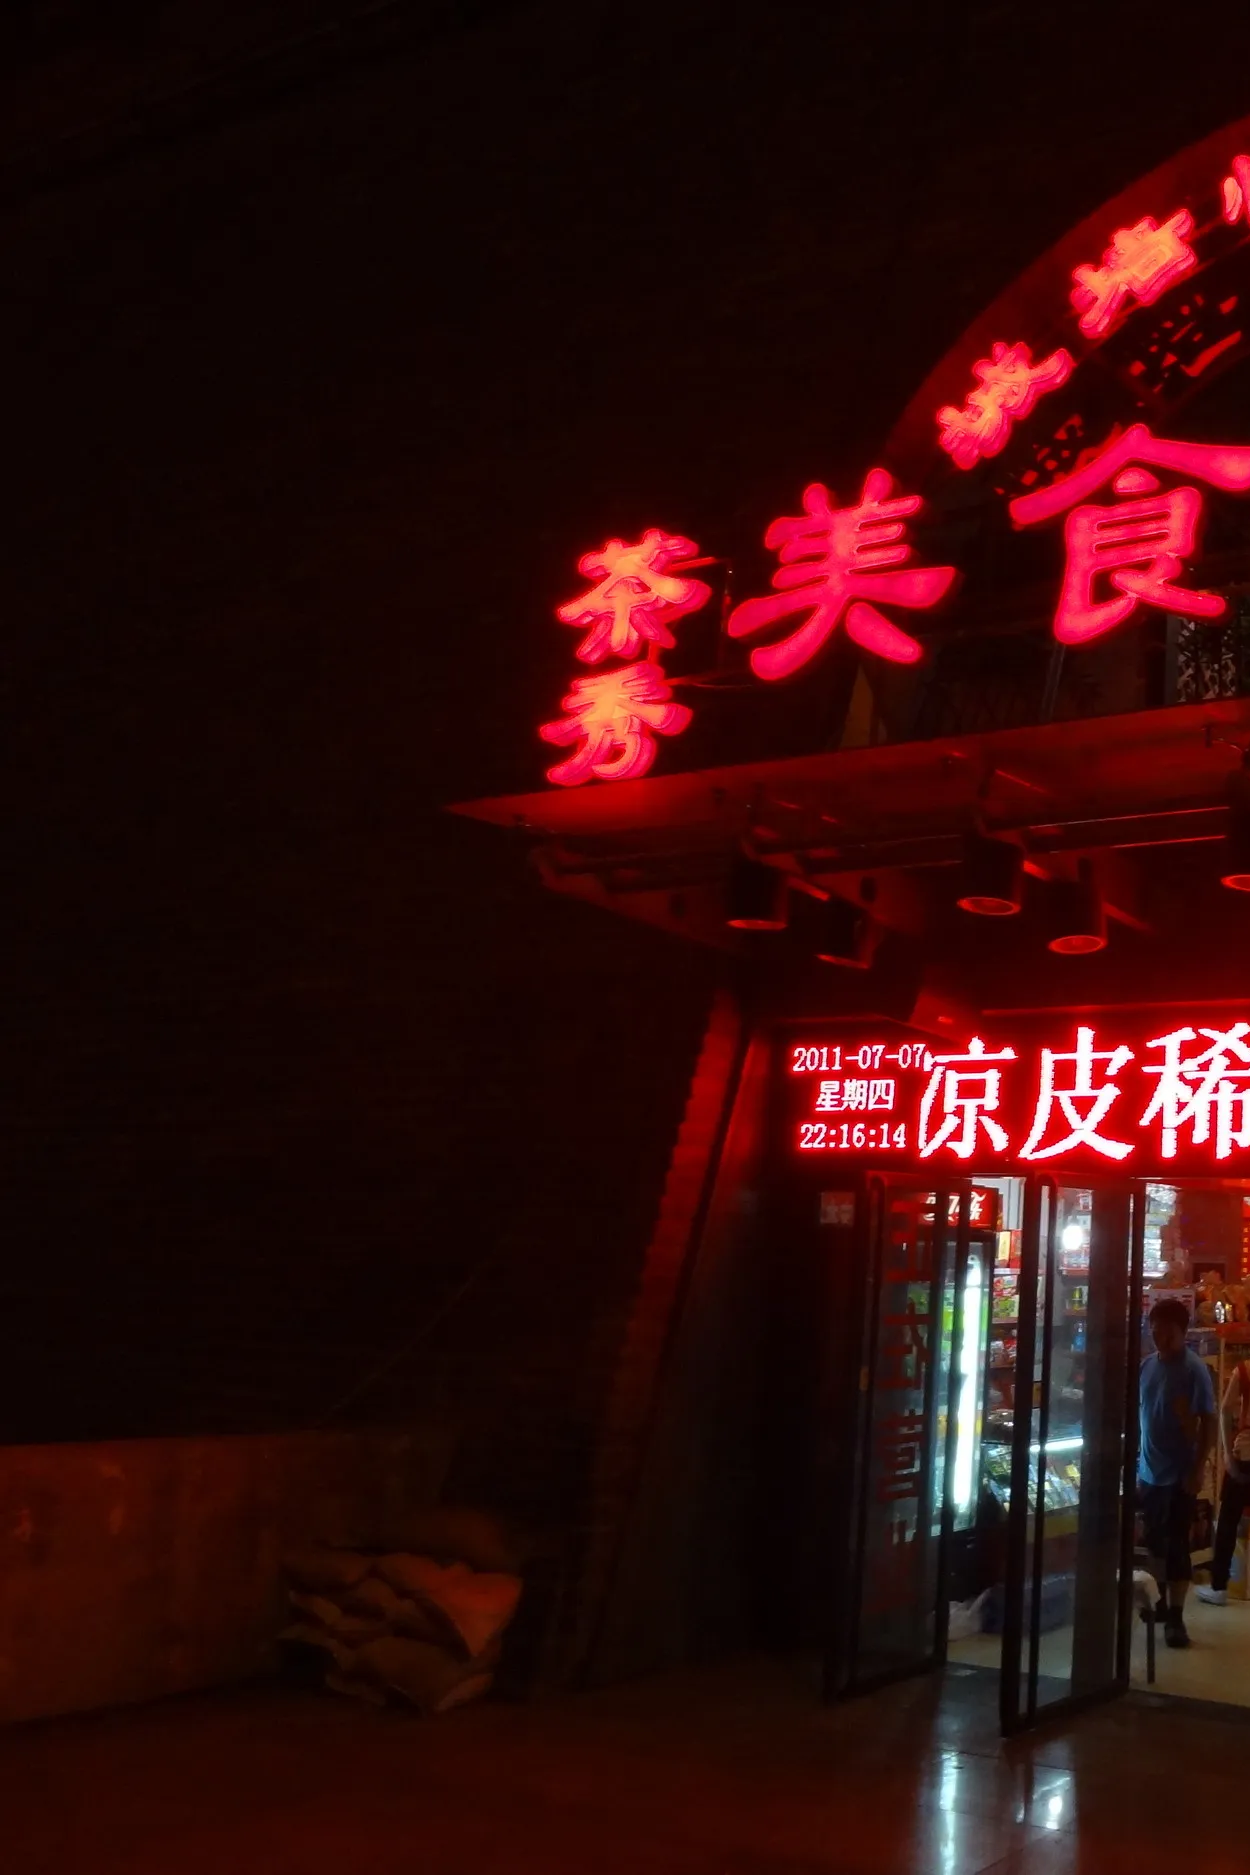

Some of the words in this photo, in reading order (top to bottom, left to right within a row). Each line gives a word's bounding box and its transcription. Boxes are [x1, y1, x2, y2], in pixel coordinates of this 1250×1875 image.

[539, 528, 712, 787] 茶秀
[792, 1044, 926, 1073] 2011-07-07
[815, 1078, 896, 1111] 星期四
[799, 1122, 907, 1149] 22:16:14
